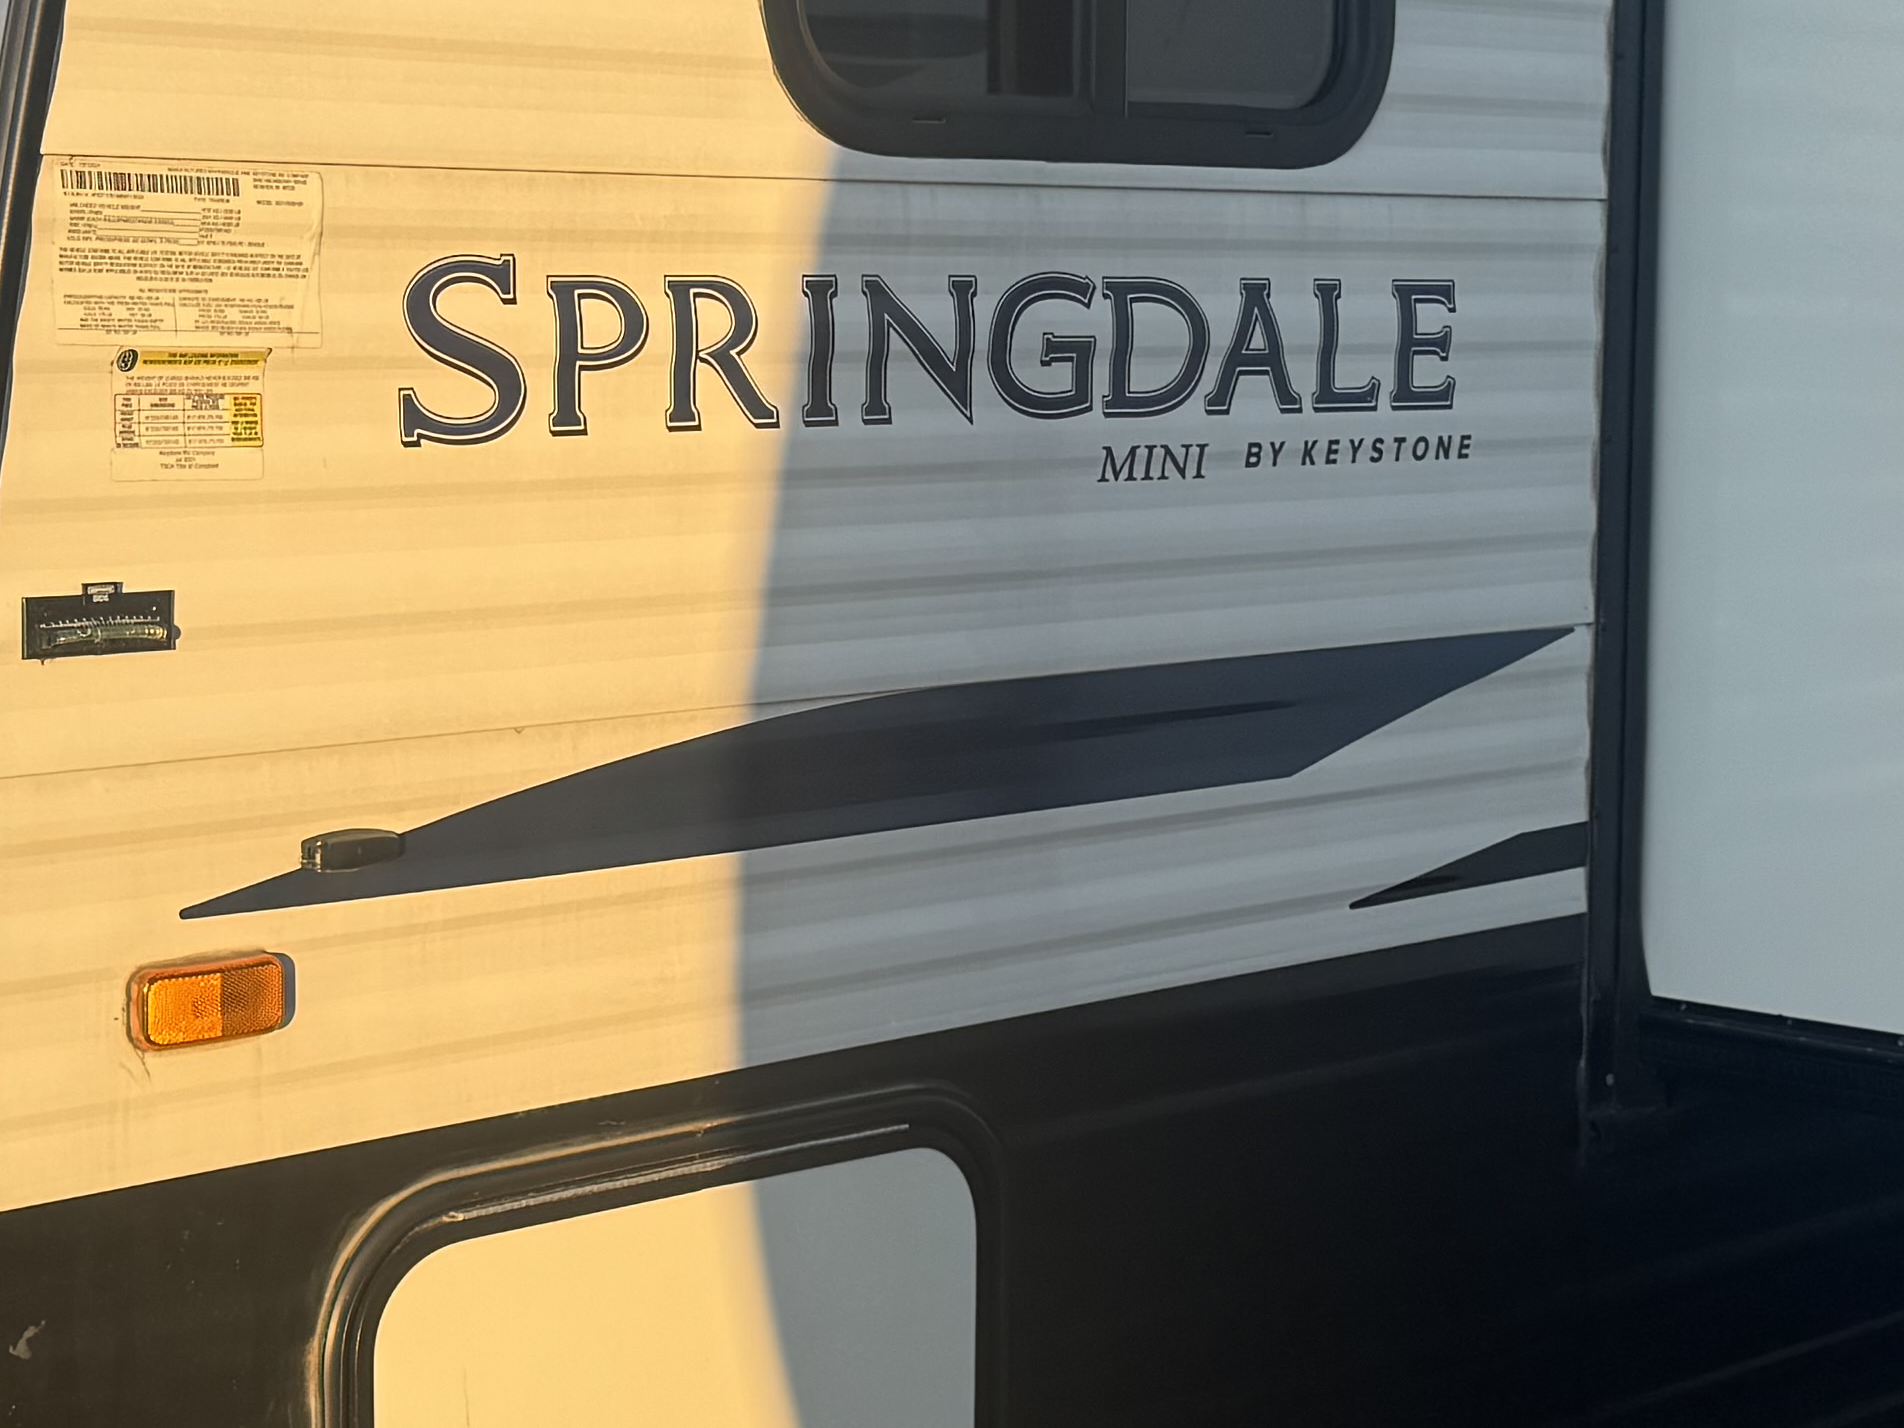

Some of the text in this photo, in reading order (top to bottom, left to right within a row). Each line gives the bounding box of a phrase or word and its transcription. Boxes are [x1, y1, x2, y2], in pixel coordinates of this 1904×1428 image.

[398, 253, 1458, 448] SPRINGDALE
[1097, 434, 1474, 484] MINI BY KEYSTONE
